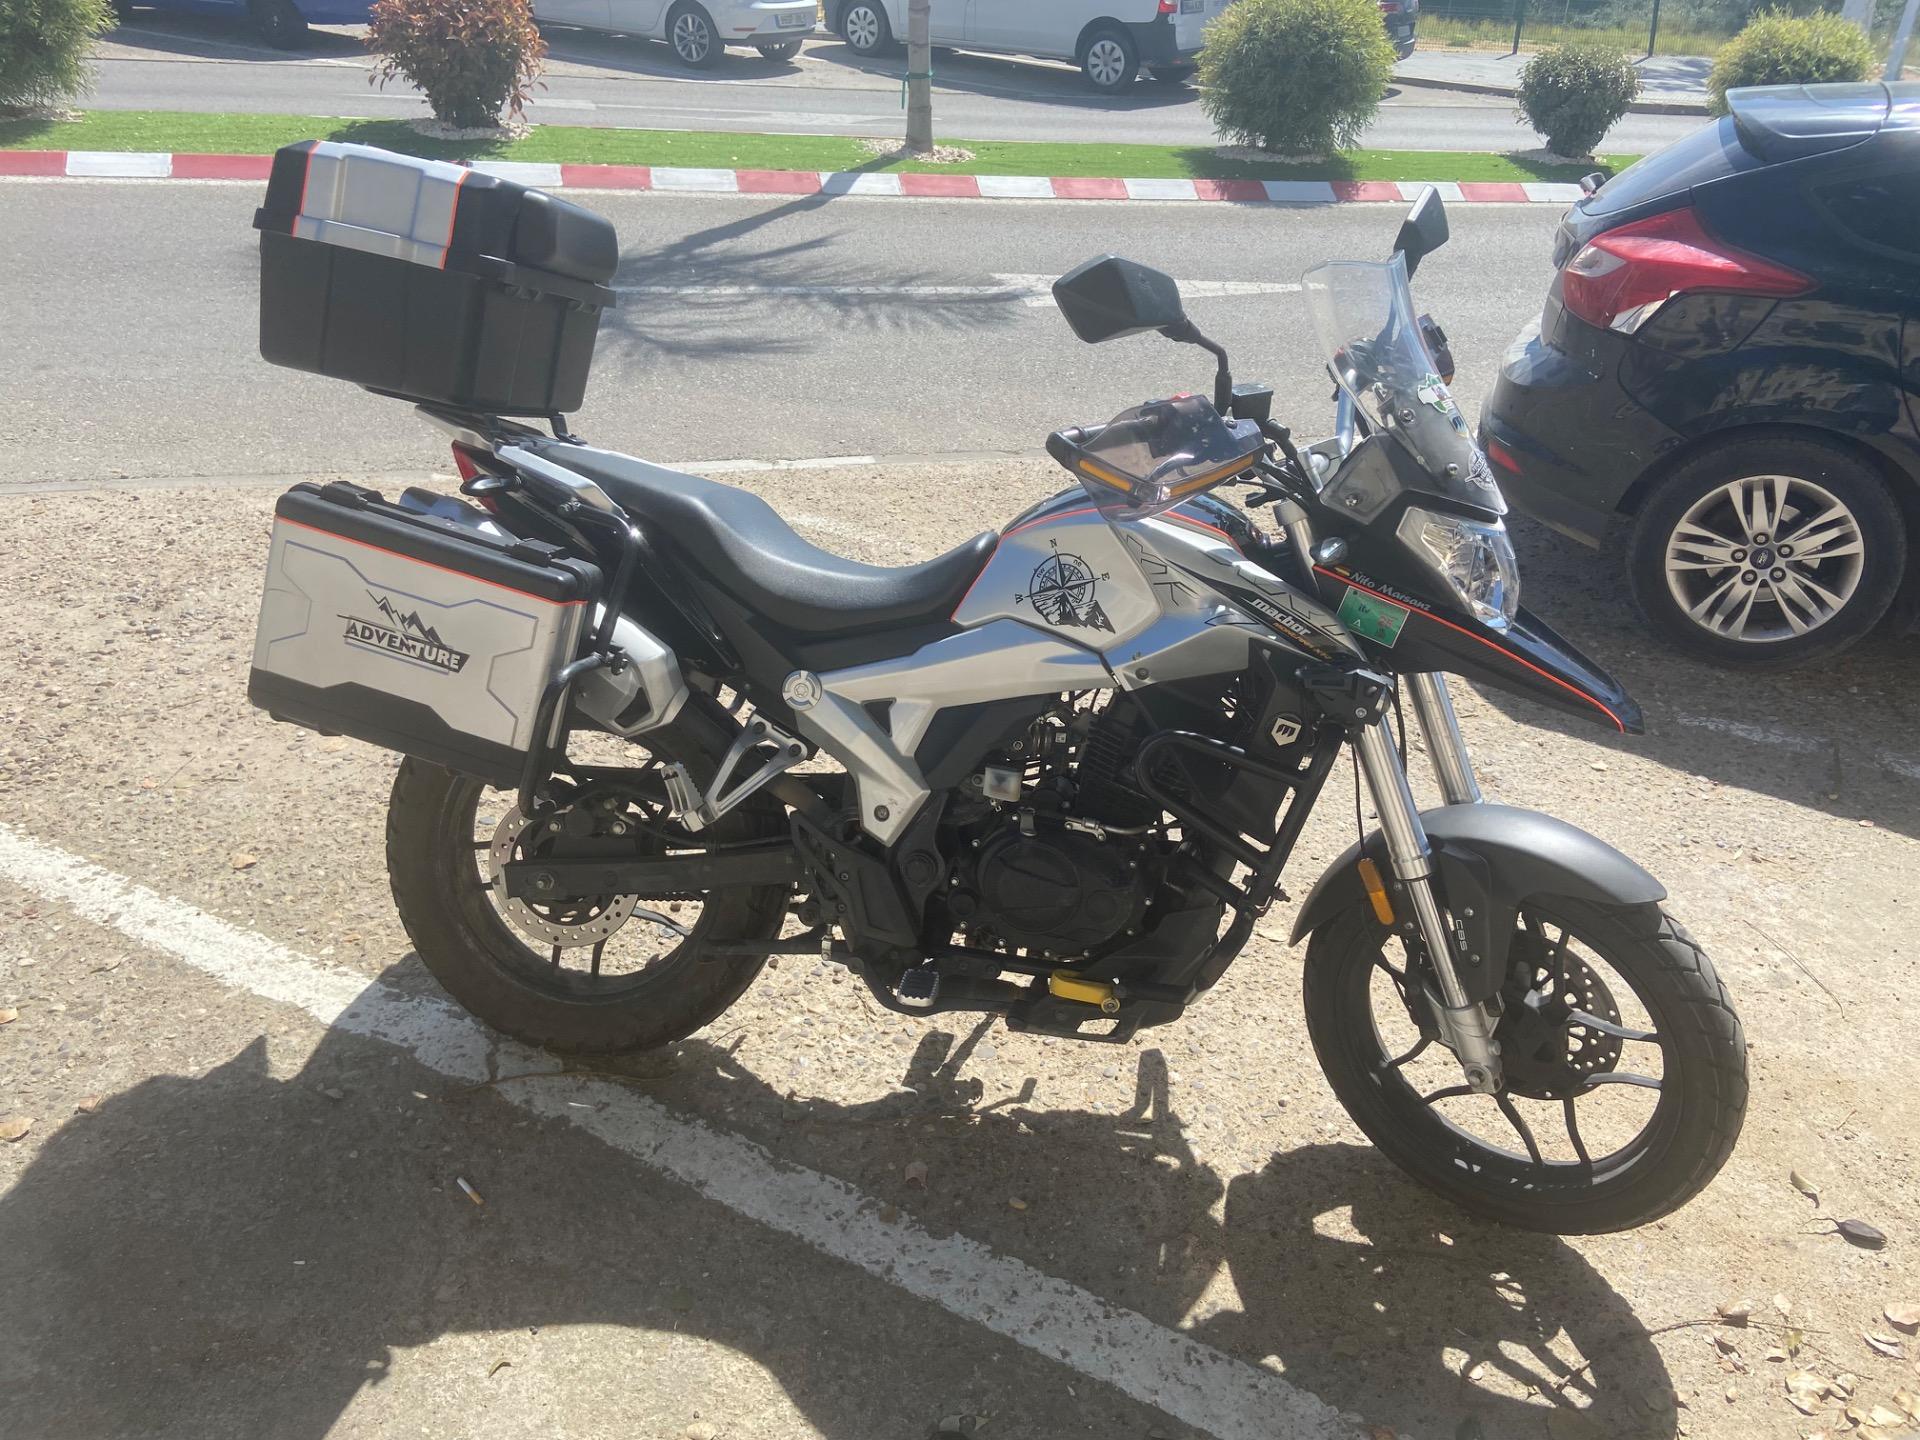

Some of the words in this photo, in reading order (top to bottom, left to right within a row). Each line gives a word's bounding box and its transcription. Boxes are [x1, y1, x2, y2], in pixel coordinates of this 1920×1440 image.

[1049, 538, 1057, 548] N
[345, 621, 461, 670] ADVENTURE
[1455, 919, 1468, 951] CBS
